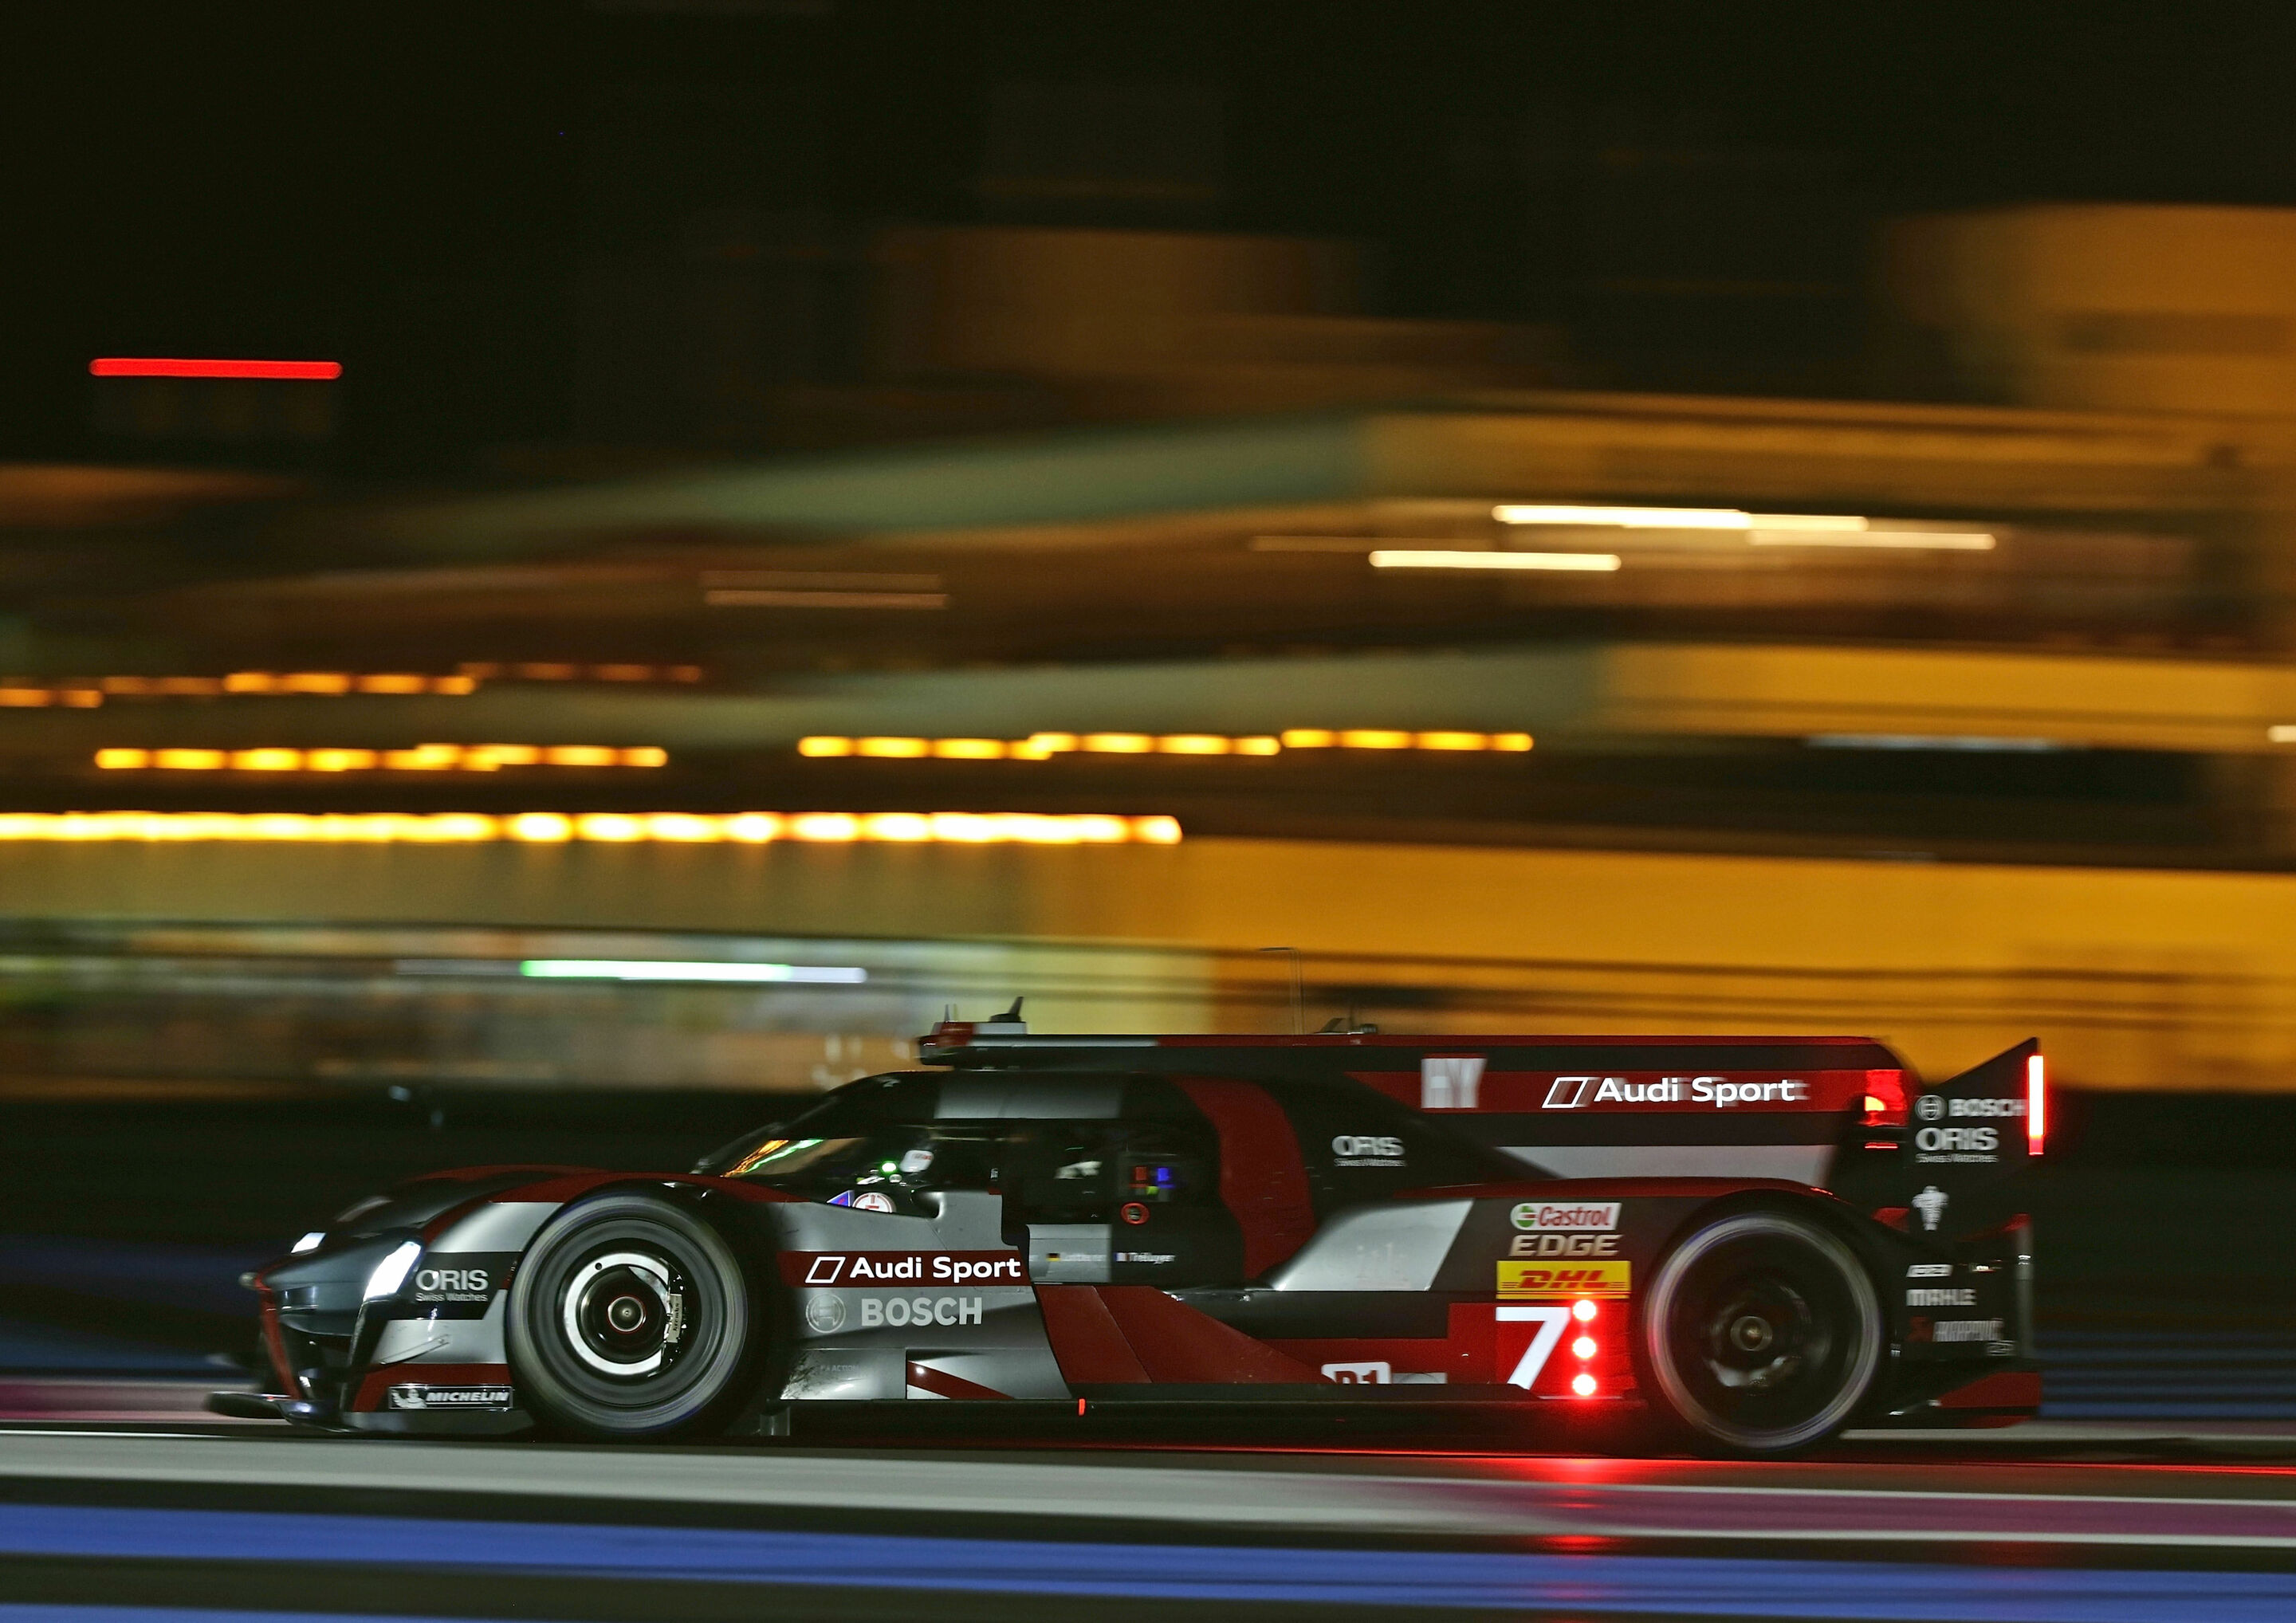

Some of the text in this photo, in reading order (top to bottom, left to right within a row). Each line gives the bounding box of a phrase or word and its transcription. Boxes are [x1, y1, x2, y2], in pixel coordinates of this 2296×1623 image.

[1594, 1076, 1796, 1108] Audi Sport
[1915, 1127, 1999, 1151] ORIS
[1539, 1206, 1611, 1226] Castrol
[1508, 1234, 1625, 1257] EDGE
[415, 1268, 489, 1291] ORIS
[849, 1256, 1022, 1283] Audi Sport
[1519, 1270, 1611, 1289] DHL
[415, 1292, 446, 1303] Swiss
[861, 1296, 983, 1327] BOSCH
[1496, 1306, 1571, 1390] 7
[425, 1391, 510, 1402] MICHELIN
